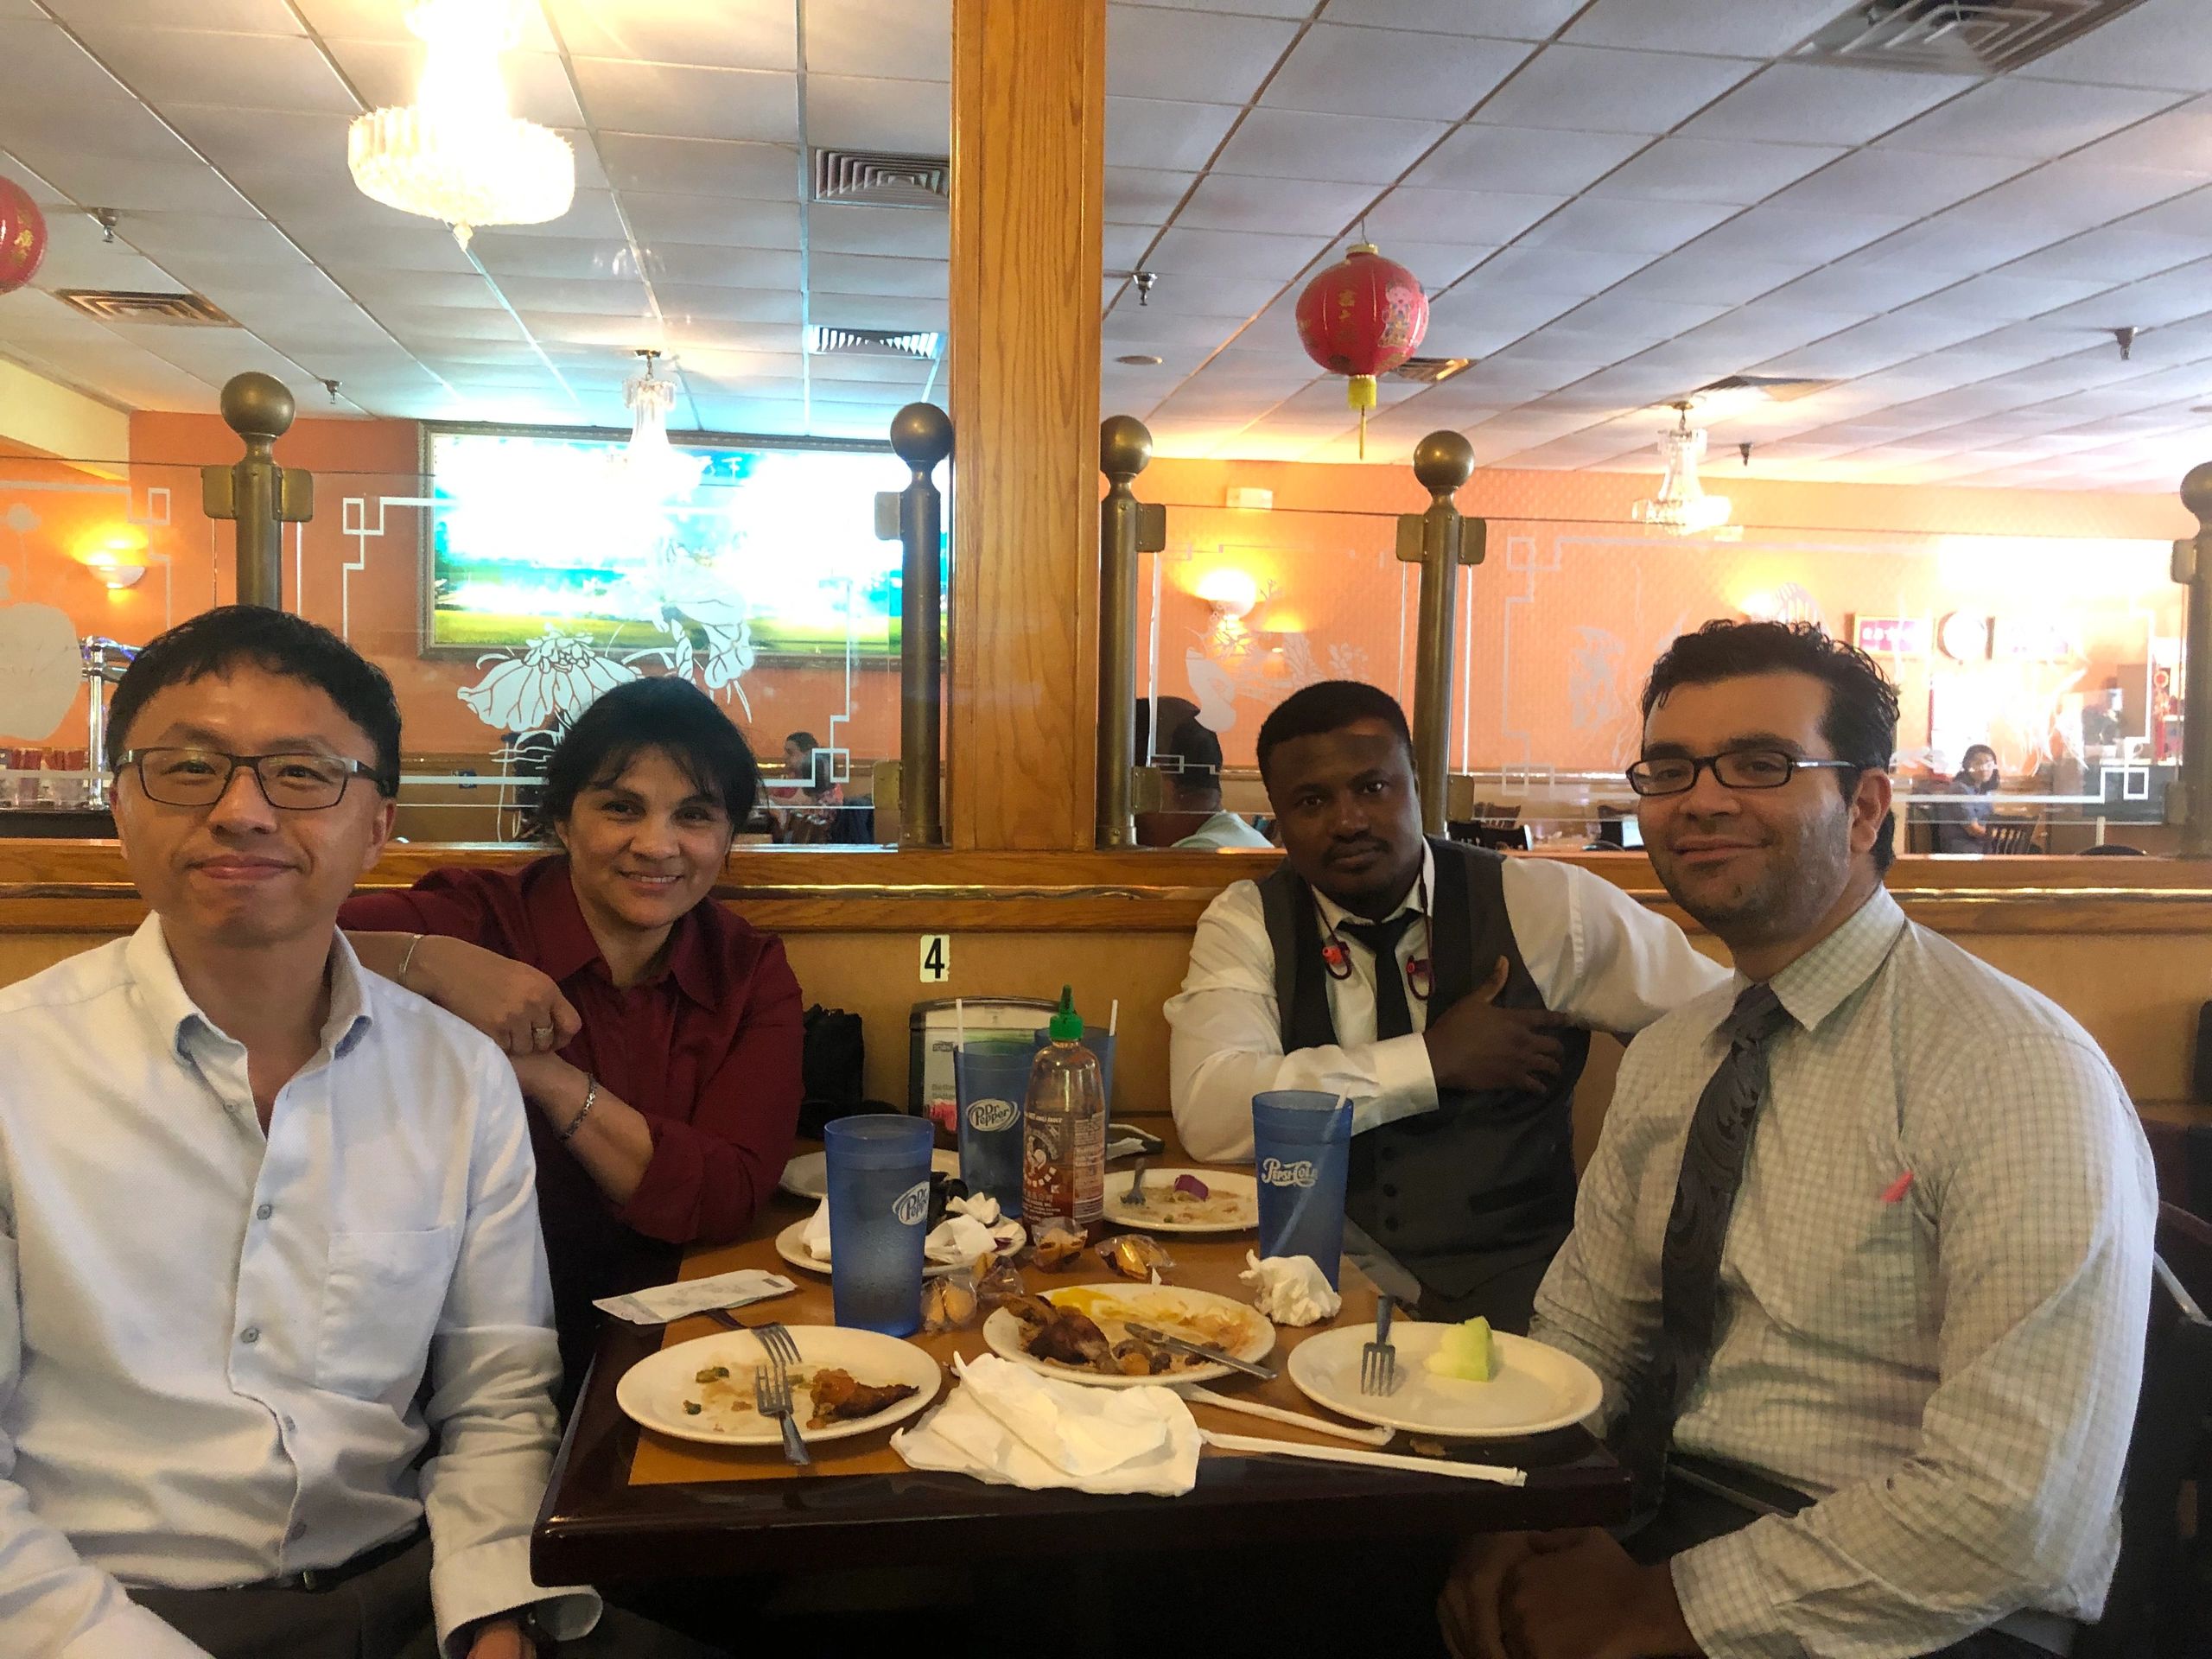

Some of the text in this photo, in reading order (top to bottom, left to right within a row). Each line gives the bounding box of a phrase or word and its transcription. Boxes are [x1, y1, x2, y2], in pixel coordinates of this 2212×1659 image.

[925, 938, 945, 980] 4
[971, 1105, 1009, 1127] Pepper
[985, 1103, 1000, 1116] Dr
